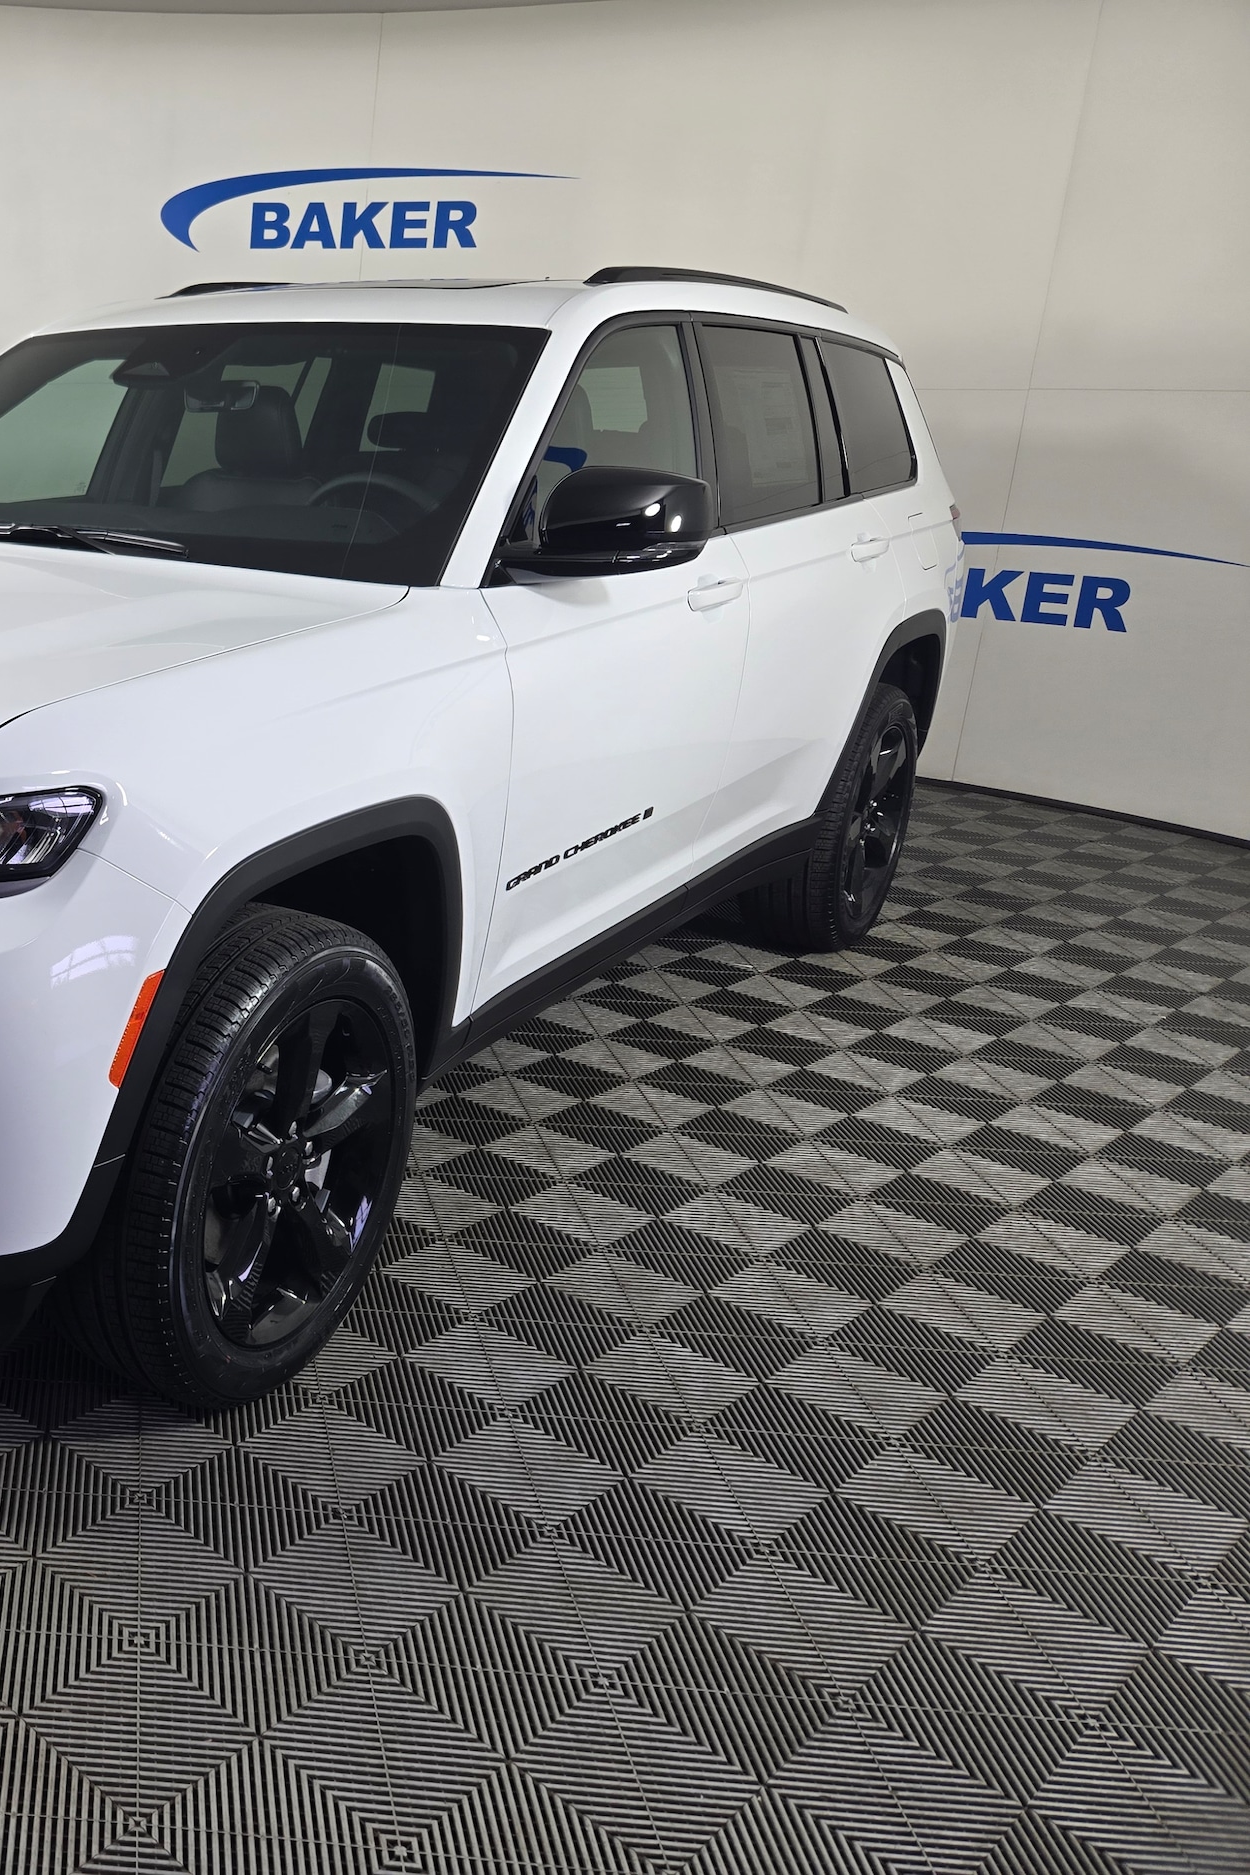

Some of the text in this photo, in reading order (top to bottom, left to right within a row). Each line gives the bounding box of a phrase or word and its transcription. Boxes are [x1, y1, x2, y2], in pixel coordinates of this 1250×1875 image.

[250, 201, 478, 249] BAKER
[960, 567, 1132, 633] KER
[505, 812, 642, 892] GRAND CHEROKEE
